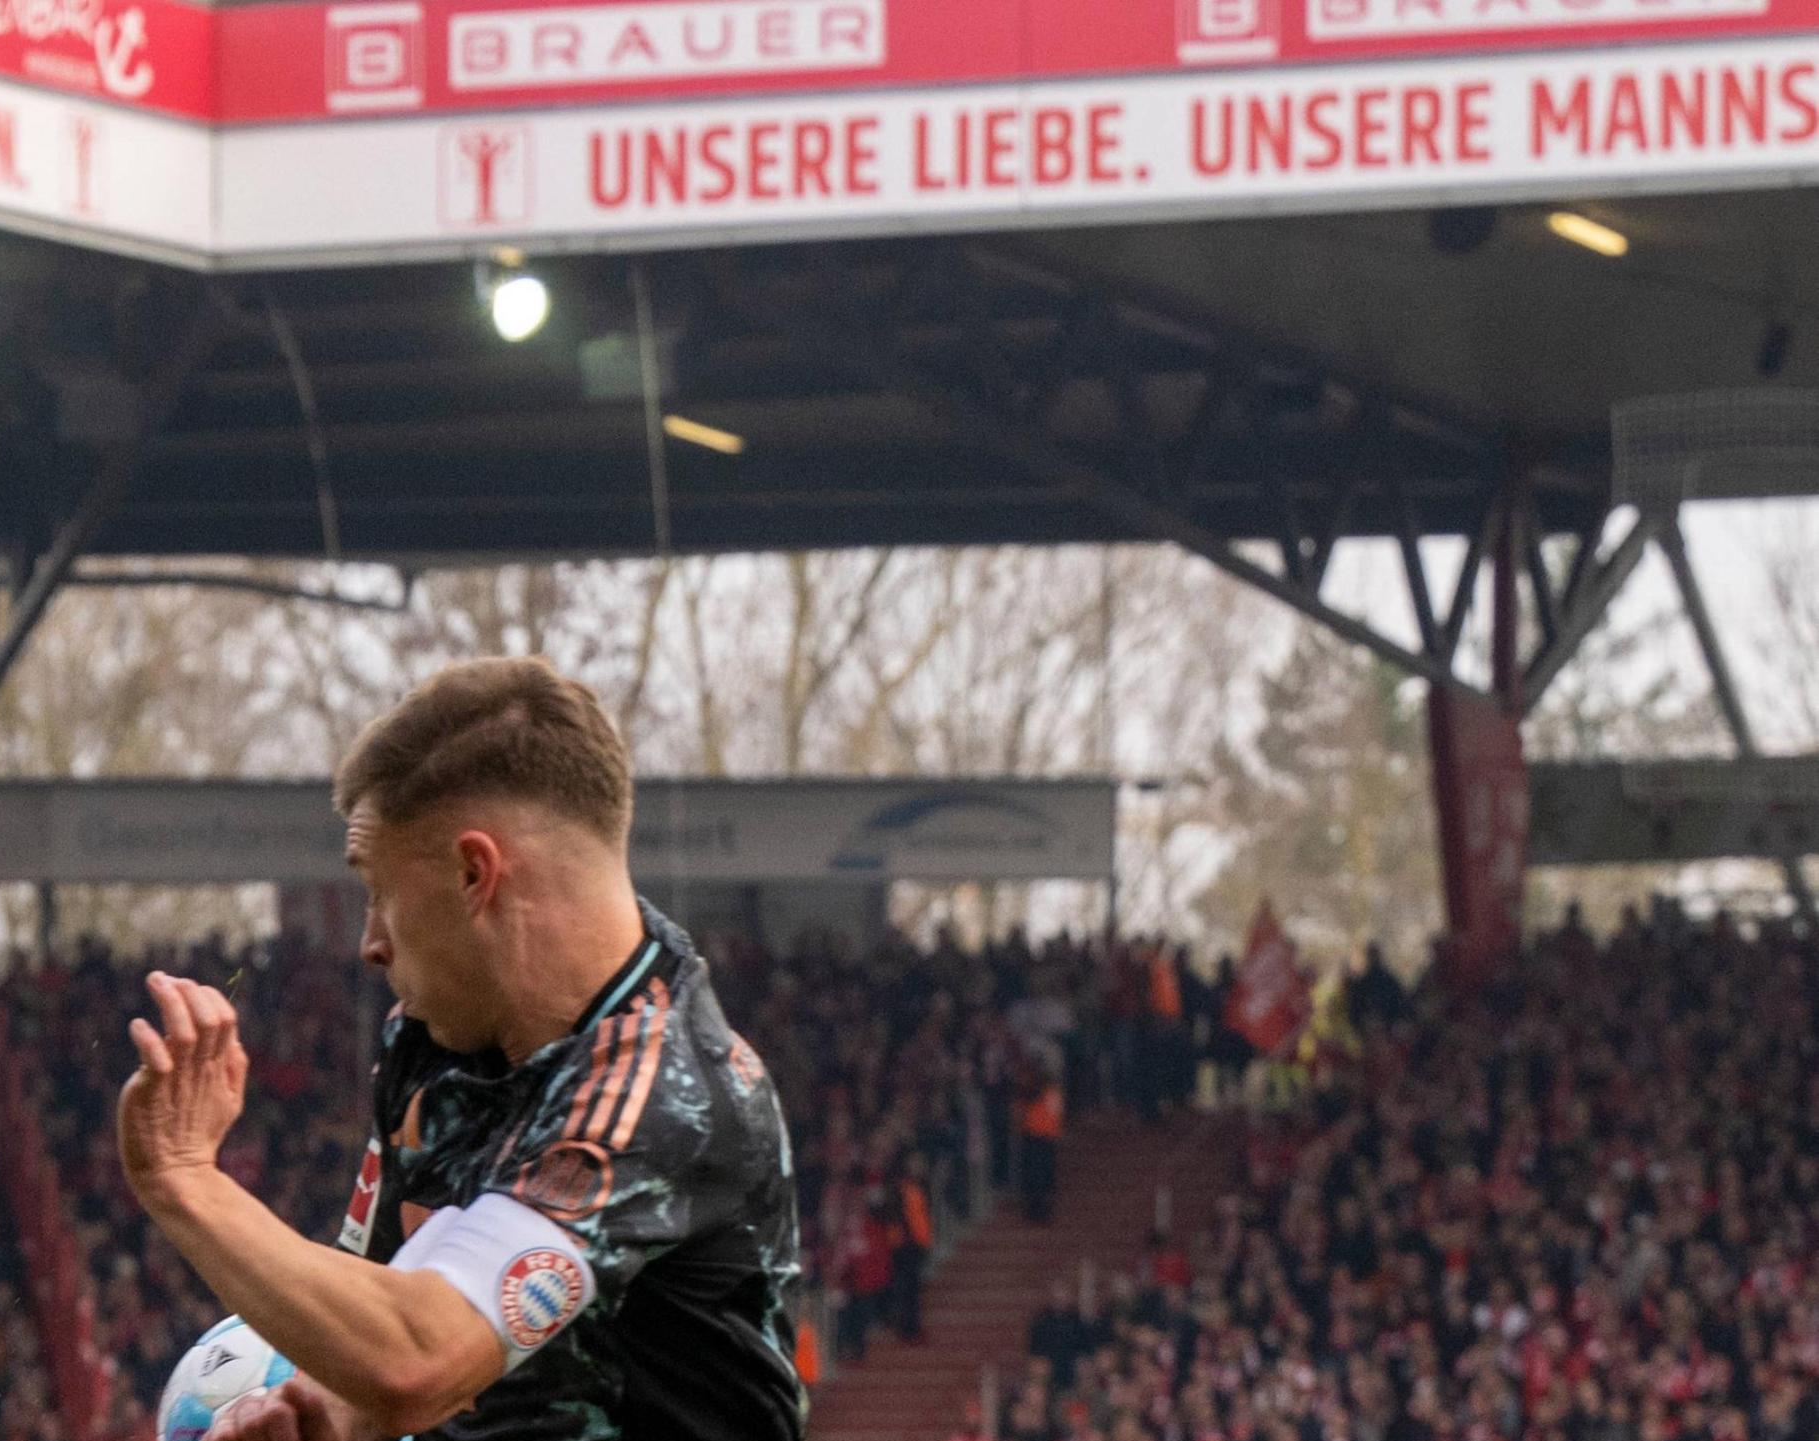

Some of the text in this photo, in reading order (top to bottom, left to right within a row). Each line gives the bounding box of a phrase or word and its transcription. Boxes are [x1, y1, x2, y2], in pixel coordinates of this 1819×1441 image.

[460, 4, 874, 78] BRAUER
[584, 60, 1819, 210] UNSERE LIEBE. UNSERE MANNS
